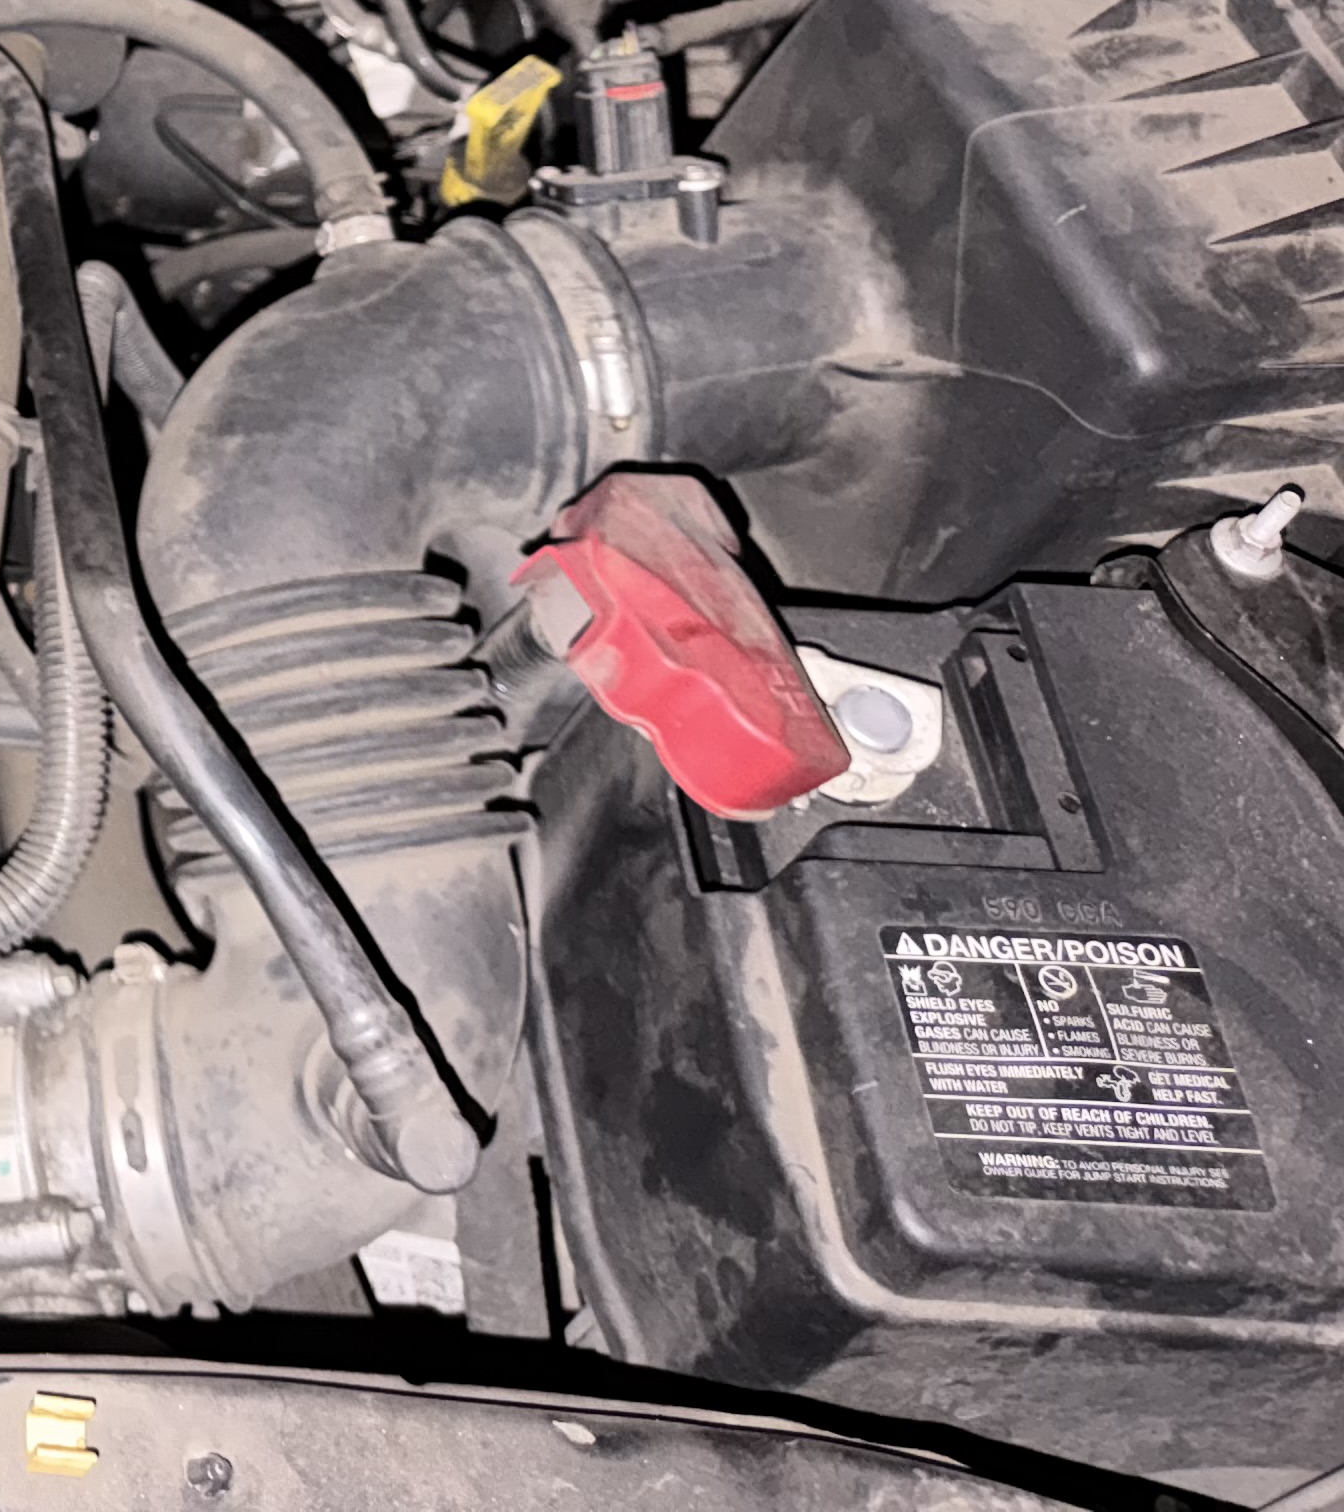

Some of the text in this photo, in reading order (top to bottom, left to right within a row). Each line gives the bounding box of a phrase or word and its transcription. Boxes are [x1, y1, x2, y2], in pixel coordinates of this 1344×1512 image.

[982, 896, 1043, 922] 590
[923, 933, 1186, 968] DANGER/POISON
[906, 996, 995, 1012] SHIELD EYES
[1036, 999, 1059, 1013] NO
[1106, 1003, 1173, 1021] SULFURIC
[910, 1011, 987, 1026] EXPLOSIVE
[1052, 1015, 1095, 1028] SPARKS
[914, 1026, 1032, 1042] GASES CAN CAUSE
[1113, 1018, 1212, 1038] ACID CAN CAUSE
[1057, 1031, 1101, 1043] FLAMES
[1116, 1033, 1200, 1051] BLINDNESS OR
[918, 1040, 980, 1055] BLINDNESS
[981, 1043, 997, 1055] OR
[1120, 1048, 1163, 1064] SEVERE
[925, 1061, 1084, 1080] FLUSH EYES IMMEDIATELY
[929, 1078, 1009, 1094] WITH WATER
[1148, 1071, 1231, 1089] GET MEDICAL
[1152, 1088, 1224, 1104] HELP FAST.
[965, 1104, 1214, 1129] KEEP OUT OF REACH OF CHILDREN.
[969, 1118, 988, 1132] DO
[990, 1119, 1015, 1133] NOT
[1042, 1122, 1073, 1137] KEEP
[1074, 1123, 1114, 1139] VENTS
[1115, 1125, 1150, 1140] TIGHT
[1153, 1127, 1179, 1142] AND
[978, 1151, 1061, 1170] WARNING:
[1062, 1159, 1077, 1170] TO
[1079, 1160, 1110, 1172] AVOID
[983, 1166, 1023, 1177] OWNER
[1024, 1168, 1057, 1179] GUIDE
[1058, 1169, 1081, 1180] FOR
[1113, 1172, 1147, 1183] START
